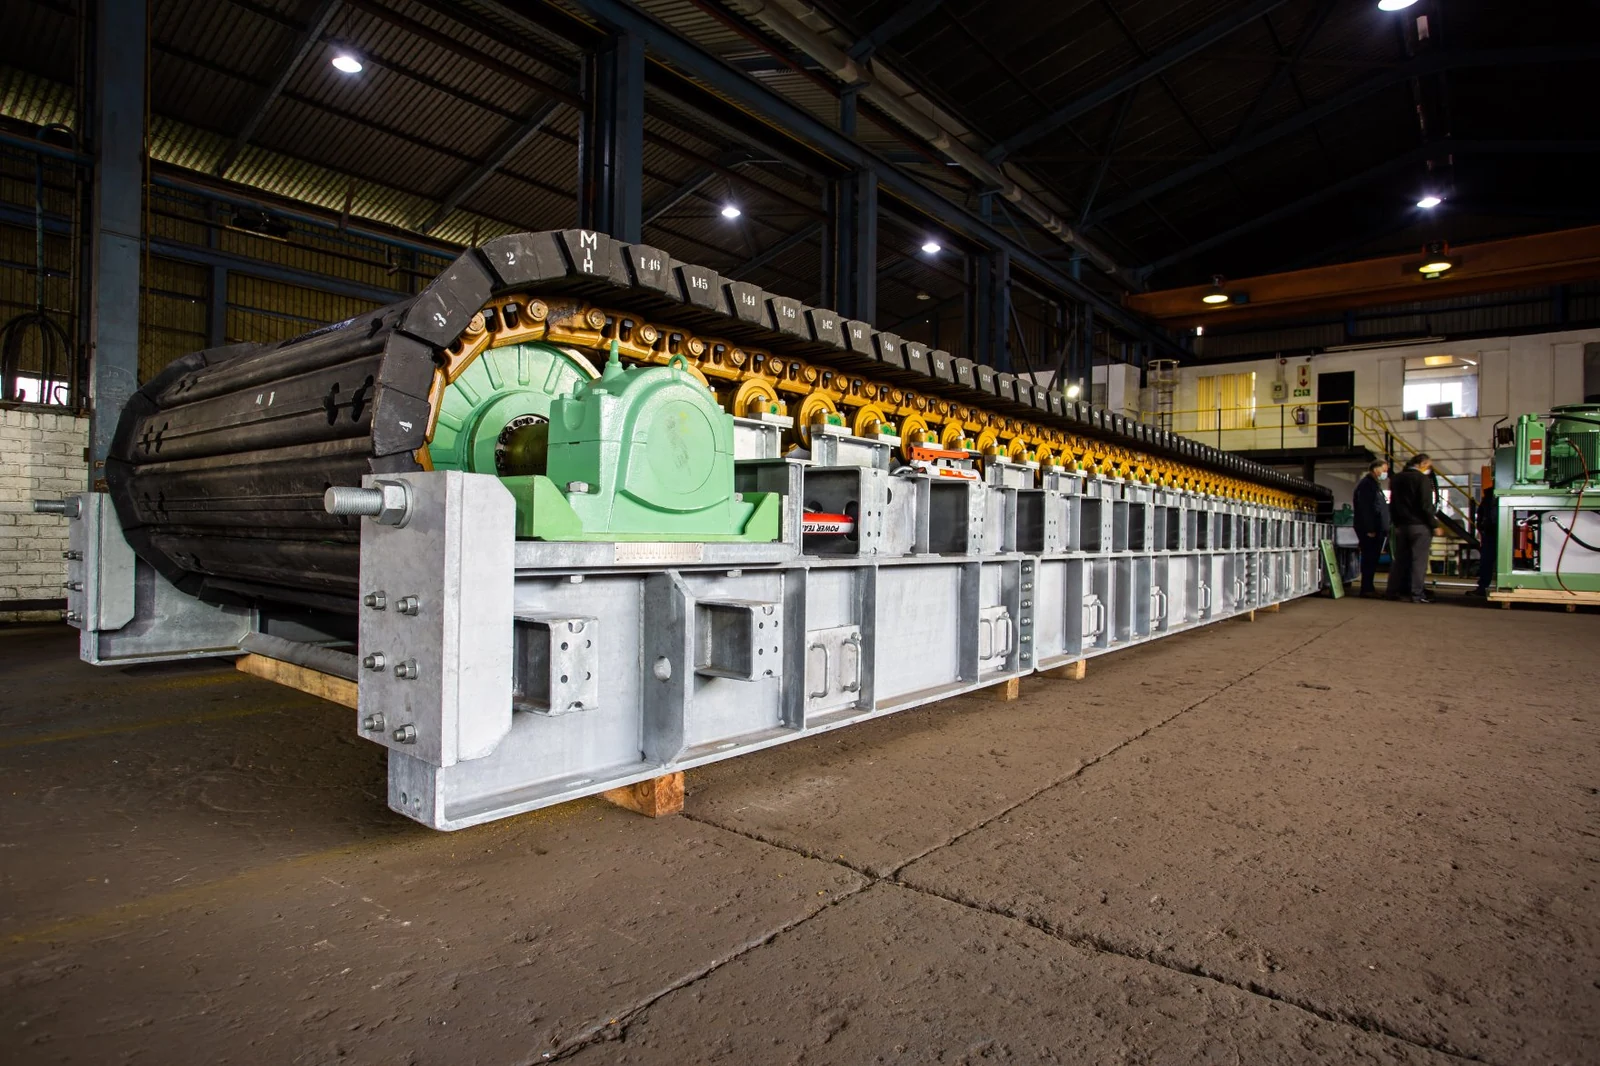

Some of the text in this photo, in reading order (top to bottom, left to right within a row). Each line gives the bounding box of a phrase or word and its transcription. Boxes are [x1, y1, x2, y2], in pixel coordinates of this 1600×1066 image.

[506, 251, 516, 265] 2
[692, 276, 708, 290] 145
[742, 292, 755, 306] 144
[782, 305, 796, 319] 143
[433, 312, 447, 327] 3
[816, 523, 840, 532] POWER
